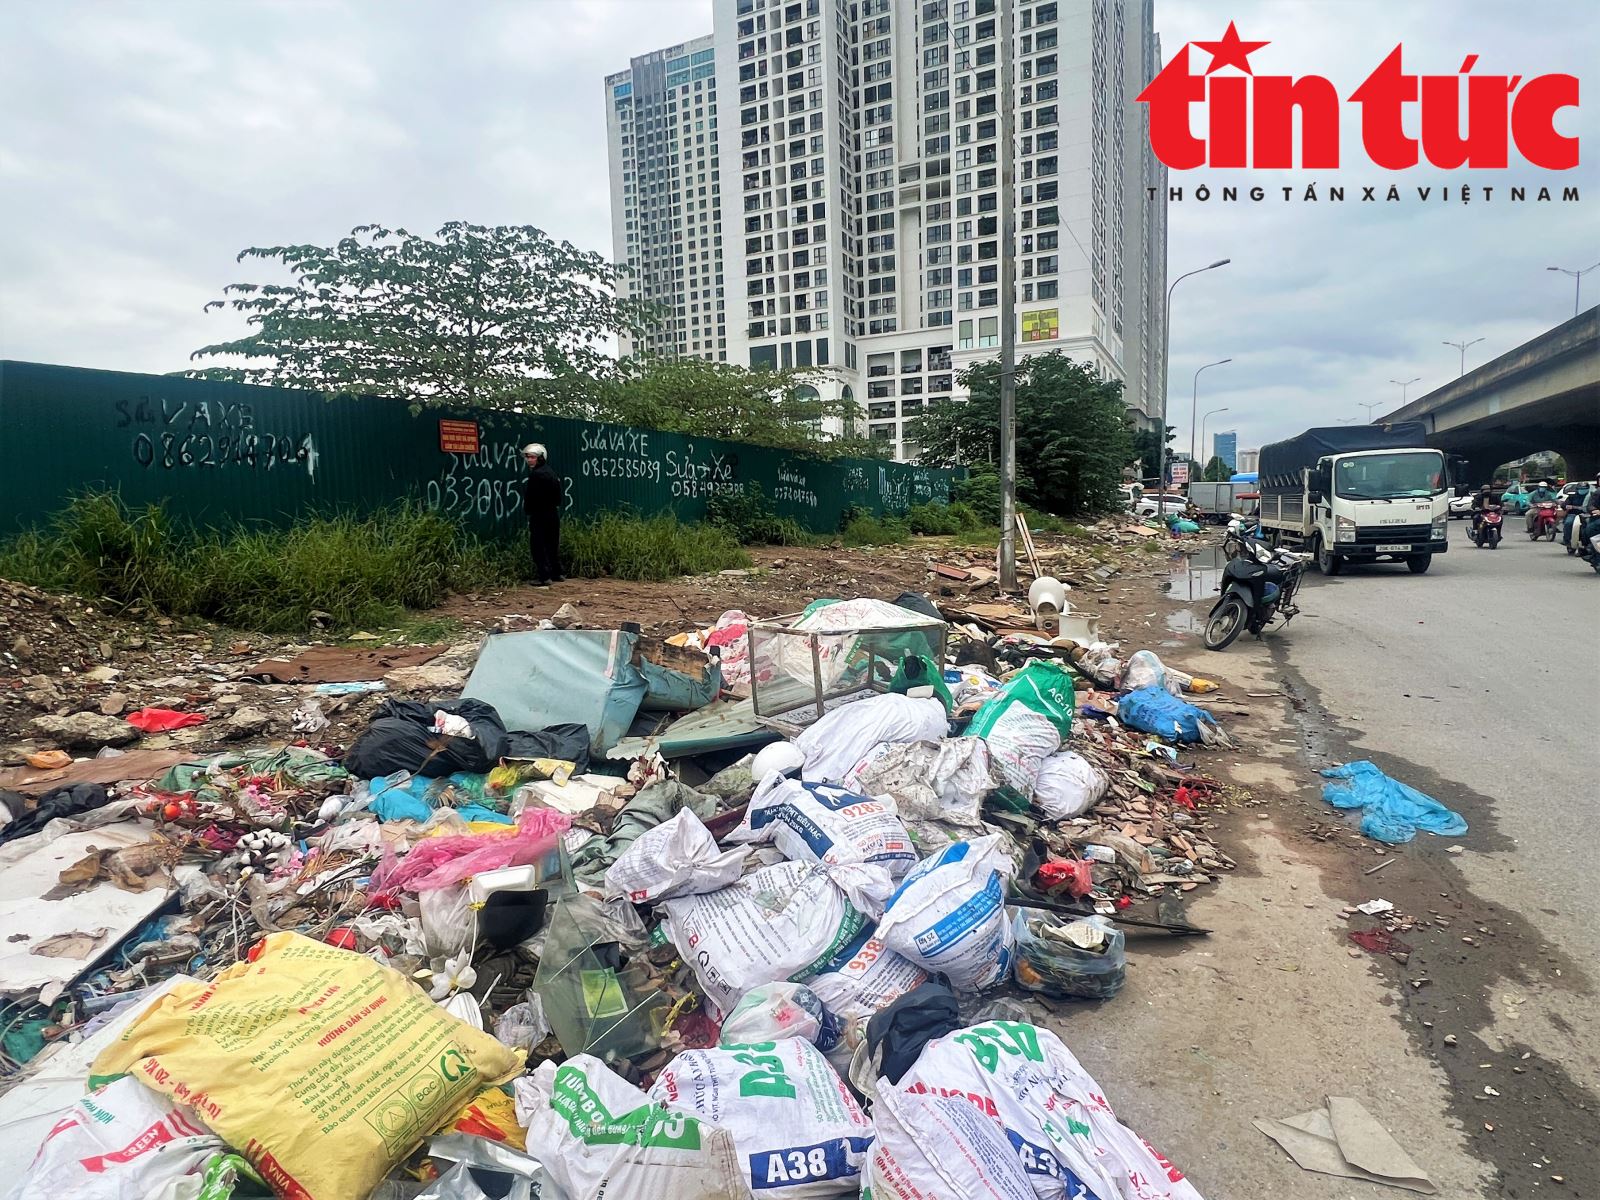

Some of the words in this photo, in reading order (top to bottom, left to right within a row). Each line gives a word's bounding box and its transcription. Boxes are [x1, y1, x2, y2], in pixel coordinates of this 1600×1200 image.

[805, 825, 822, 841] NẠC
[316, 1022, 348, 1048] HƯỚNG
[344, 1011, 363, 1029] DẪN
[359, 1003, 373, 1018] SỬ
[369, 994, 388, 1011] DỤNG
[141, 1056, 160, 1075] KG
[152, 1067, 170, 1085] 20
[286, 1072, 309, 1091] Thức
[307, 1065, 319, 1076] ăn
[317, 1056, 333, 1071] này
[293, 1080, 317, 1101] Cung
[313, 1068, 330, 1084] cấp
[301, 1090, 320, 1106] Màu
[317, 1079, 333, 1094] sắc
[332, 1073, 342, 1083] và
[341, 1063, 356, 1076] mùi
[308, 1096, 328, 1114] chất
[324, 1079, 350, 1102] lượng
[316, 1108, 330, 1121] Số
[338, 1091, 353, 1105] nơi
[351, 1081, 365, 1094] sản
[413, 1080, 439, 1102] BQC
[558, 1069, 607, 1128] JUMBO
[320, 1118, 339, 1135] Bảo
[337, 1105, 357, 1123] quản
[355, 1095, 369, 1108] nơi
[366, 1086, 381, 1099] khô
[119, 1127, 161, 1159] GREEN
[766, 1148, 827, 1184] A38
